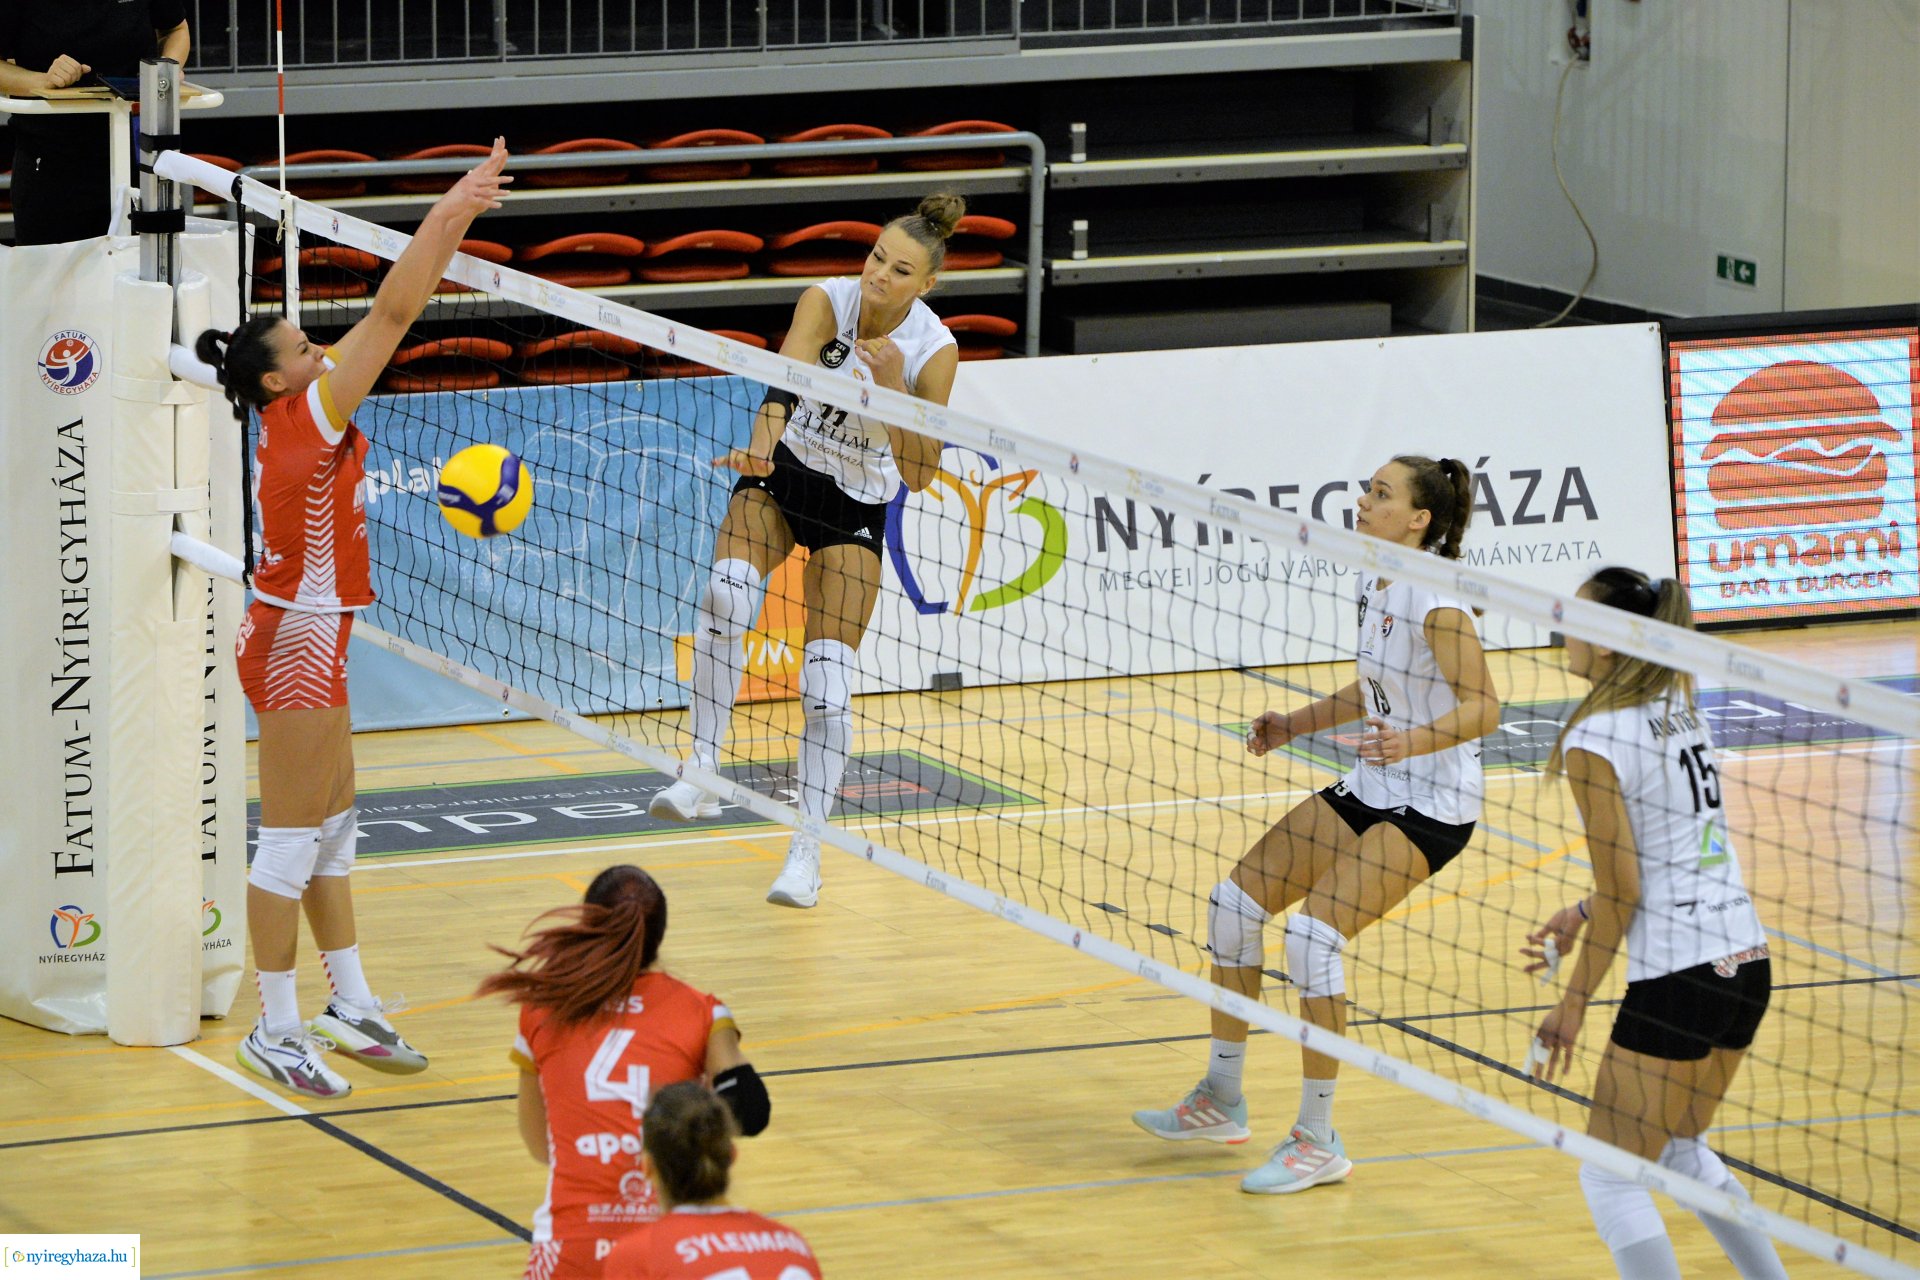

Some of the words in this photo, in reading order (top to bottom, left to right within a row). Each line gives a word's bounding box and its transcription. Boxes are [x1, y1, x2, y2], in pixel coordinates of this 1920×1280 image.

[54, 331, 87, 342] FATUM
[798, 405, 871, 452] ATUM
[1099, 567, 1192, 592] MEGYEI
[1204, 556, 1270, 585] JOGÚ
[1281, 555, 1362, 579] VÁRO
[1464, 539, 1602, 565] MÁNYZATA
[1708, 520, 1901, 573] umami
[1720, 578, 1770, 598] BAR
[1679, 743, 1721, 814] 15
[39, 952, 106, 964] NYÍREGYHÁZ
[202, 938, 232, 951] YHÁZA
[584, 1028, 650, 1119] 4
